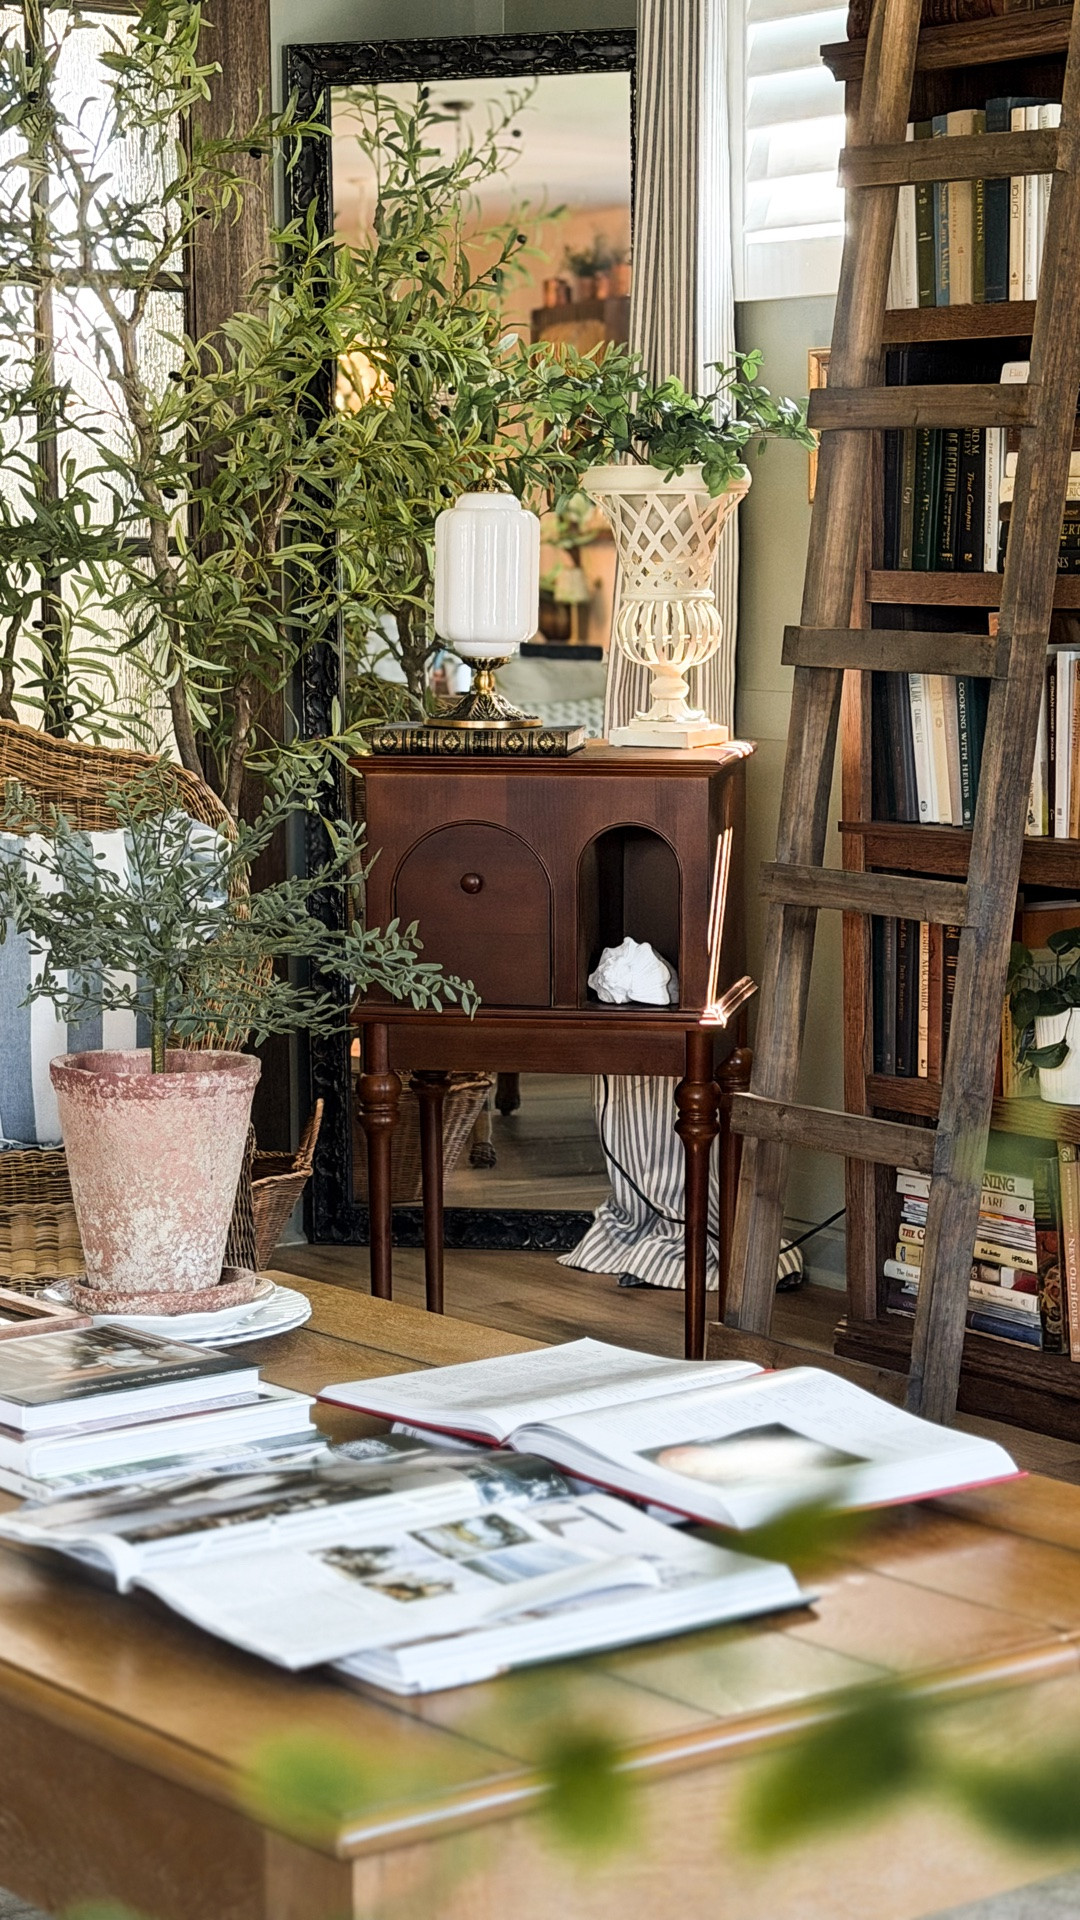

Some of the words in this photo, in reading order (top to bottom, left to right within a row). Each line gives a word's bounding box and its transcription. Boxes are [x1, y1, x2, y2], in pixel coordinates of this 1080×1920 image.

[976, 179, 984, 242] QUENTINS
[944, 446, 958, 493] DECEPTION
[966, 472, 975, 491] True
[964, 493, 975, 531] Compass
[958, 682, 967, 729] COOKING
[960, 731, 968, 760] WITH
[962, 763, 970, 799] HERBS
[921, 923, 929, 956] DEBBIE
[920, 958, 929, 1013] MACOMBER
[902, 1227, 915, 1239] THE
[1011, 1254, 1034, 1266] HPBooks
[1069, 1267, 1077, 1290] OLD
[1070, 1291, 1078, 1330] HOUSE
